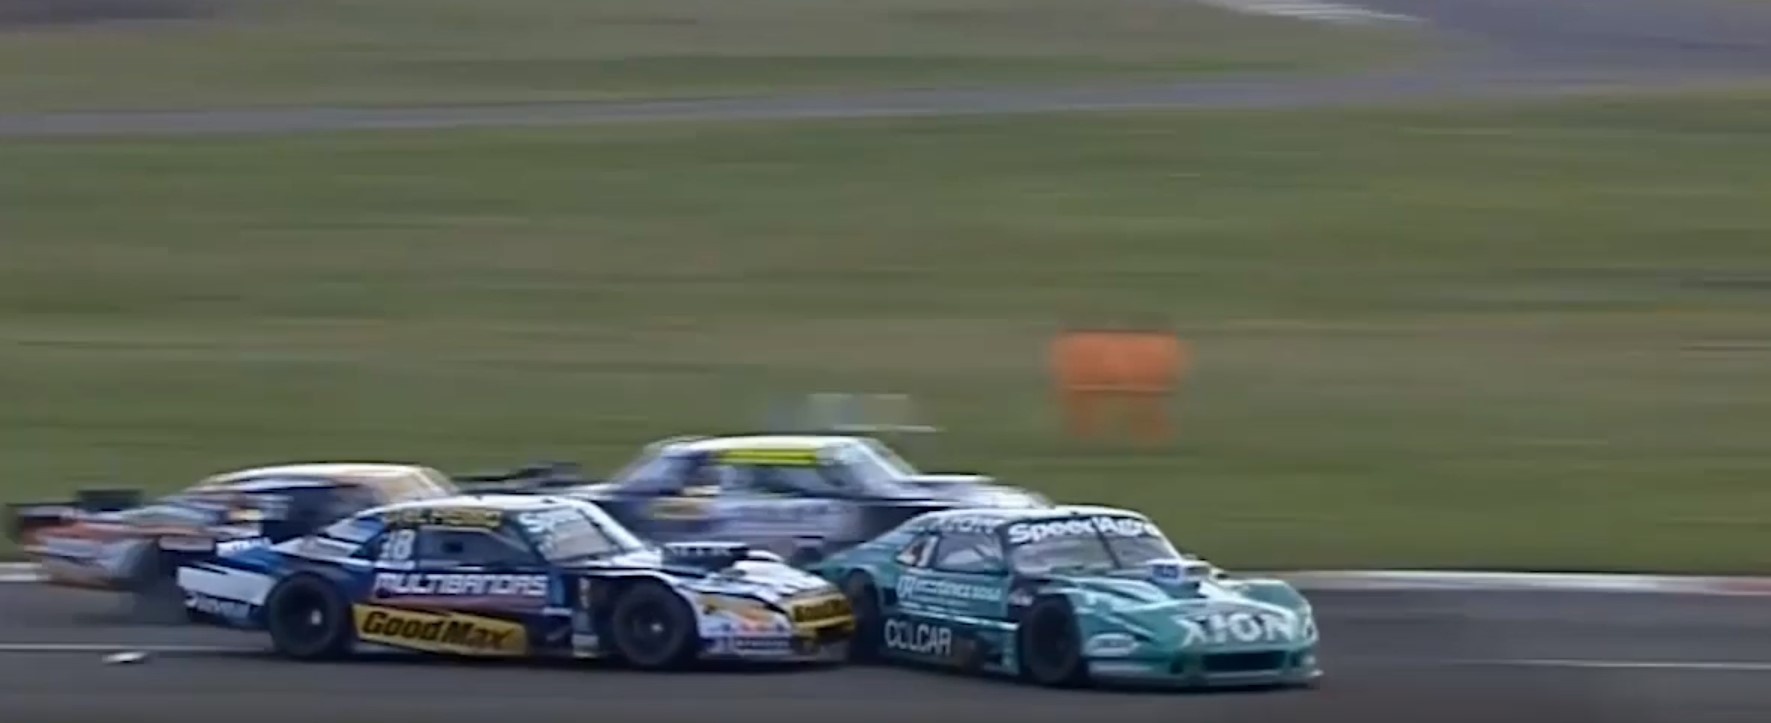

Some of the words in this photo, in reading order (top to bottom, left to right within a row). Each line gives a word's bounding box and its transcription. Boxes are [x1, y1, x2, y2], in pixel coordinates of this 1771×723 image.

[1008, 516, 1161, 543] SpeedAgro
[373, 571, 548, 597] MULTIBANDAS
[884, 617, 952, 656] COLCAR
